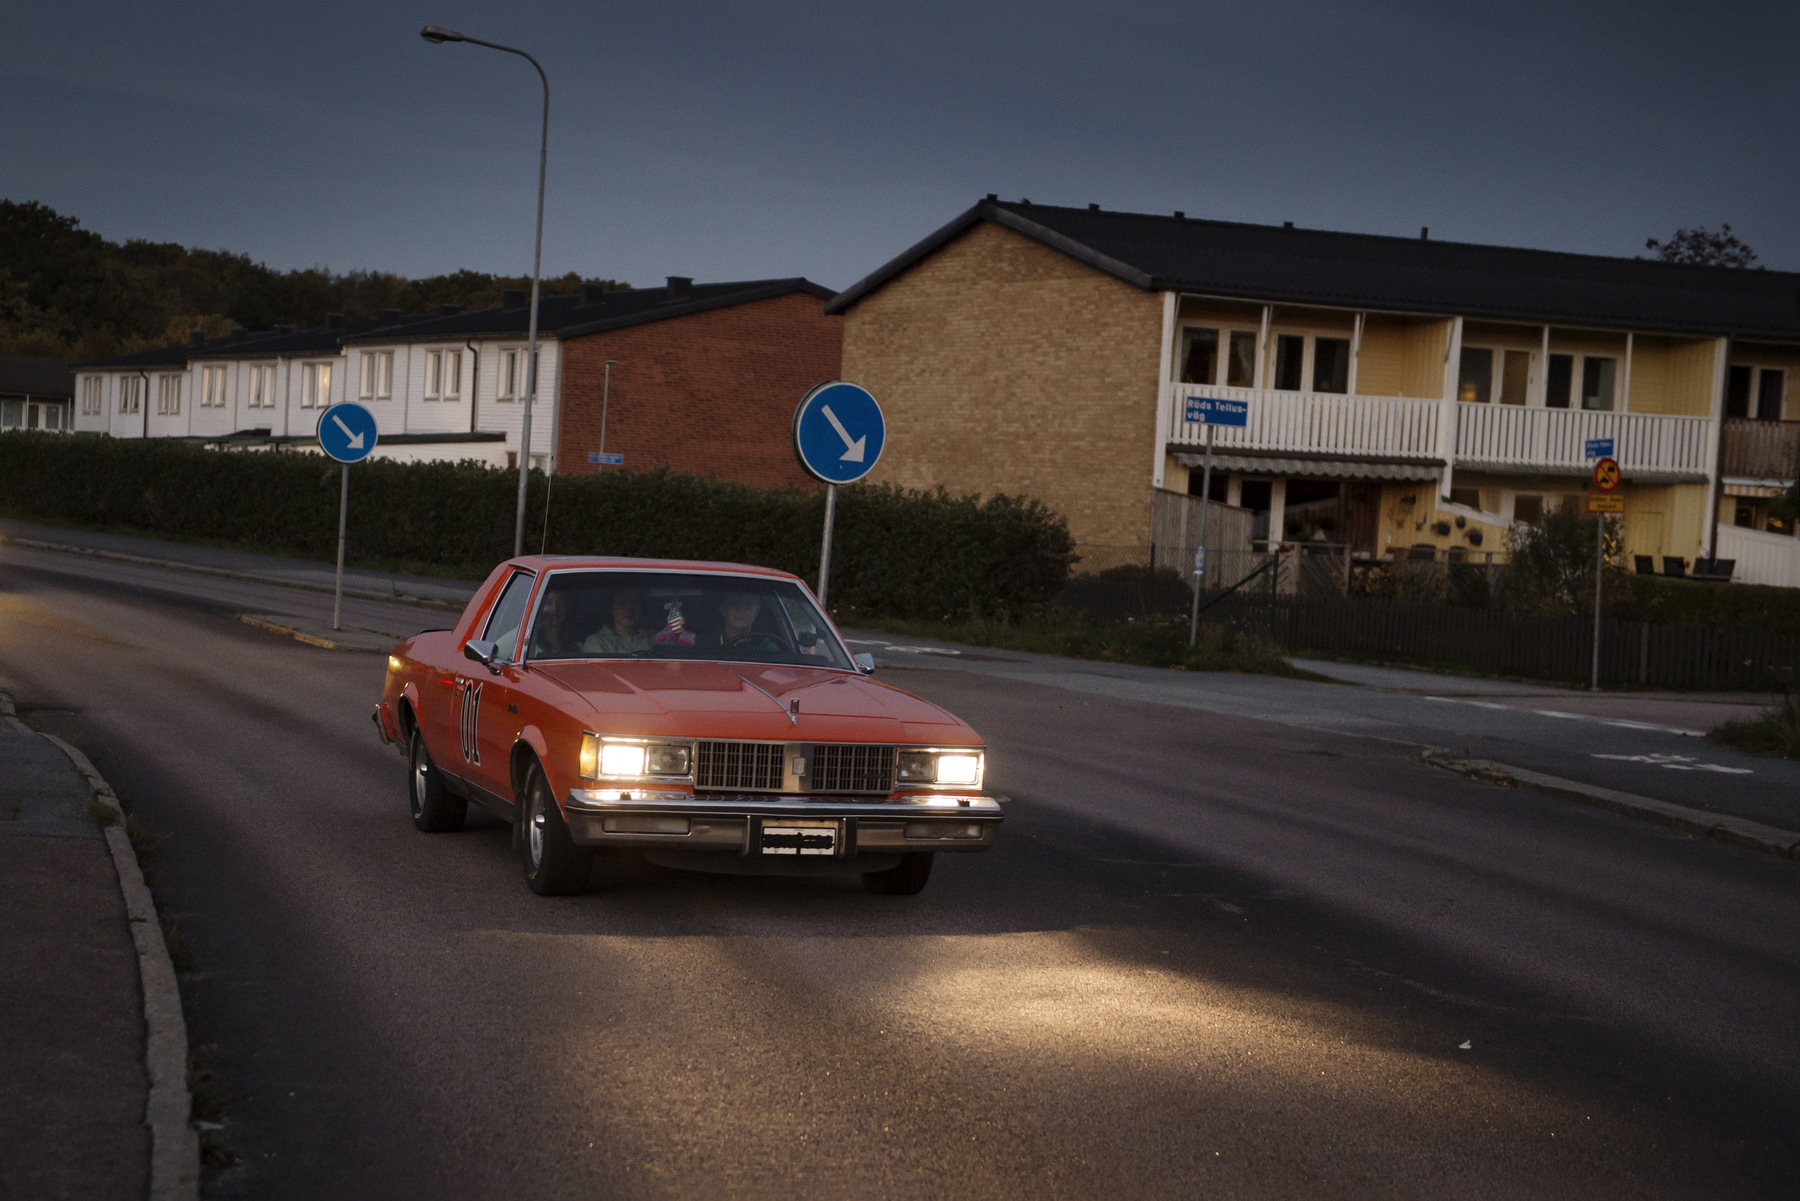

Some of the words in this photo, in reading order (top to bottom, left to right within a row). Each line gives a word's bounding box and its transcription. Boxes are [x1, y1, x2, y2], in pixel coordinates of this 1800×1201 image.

[1187, 399, 1211, 410] Röds
[1215, 401, 1246, 413] Tellus-
[1187, 410, 1205, 421] väg
[461, 679, 483, 767] 01
